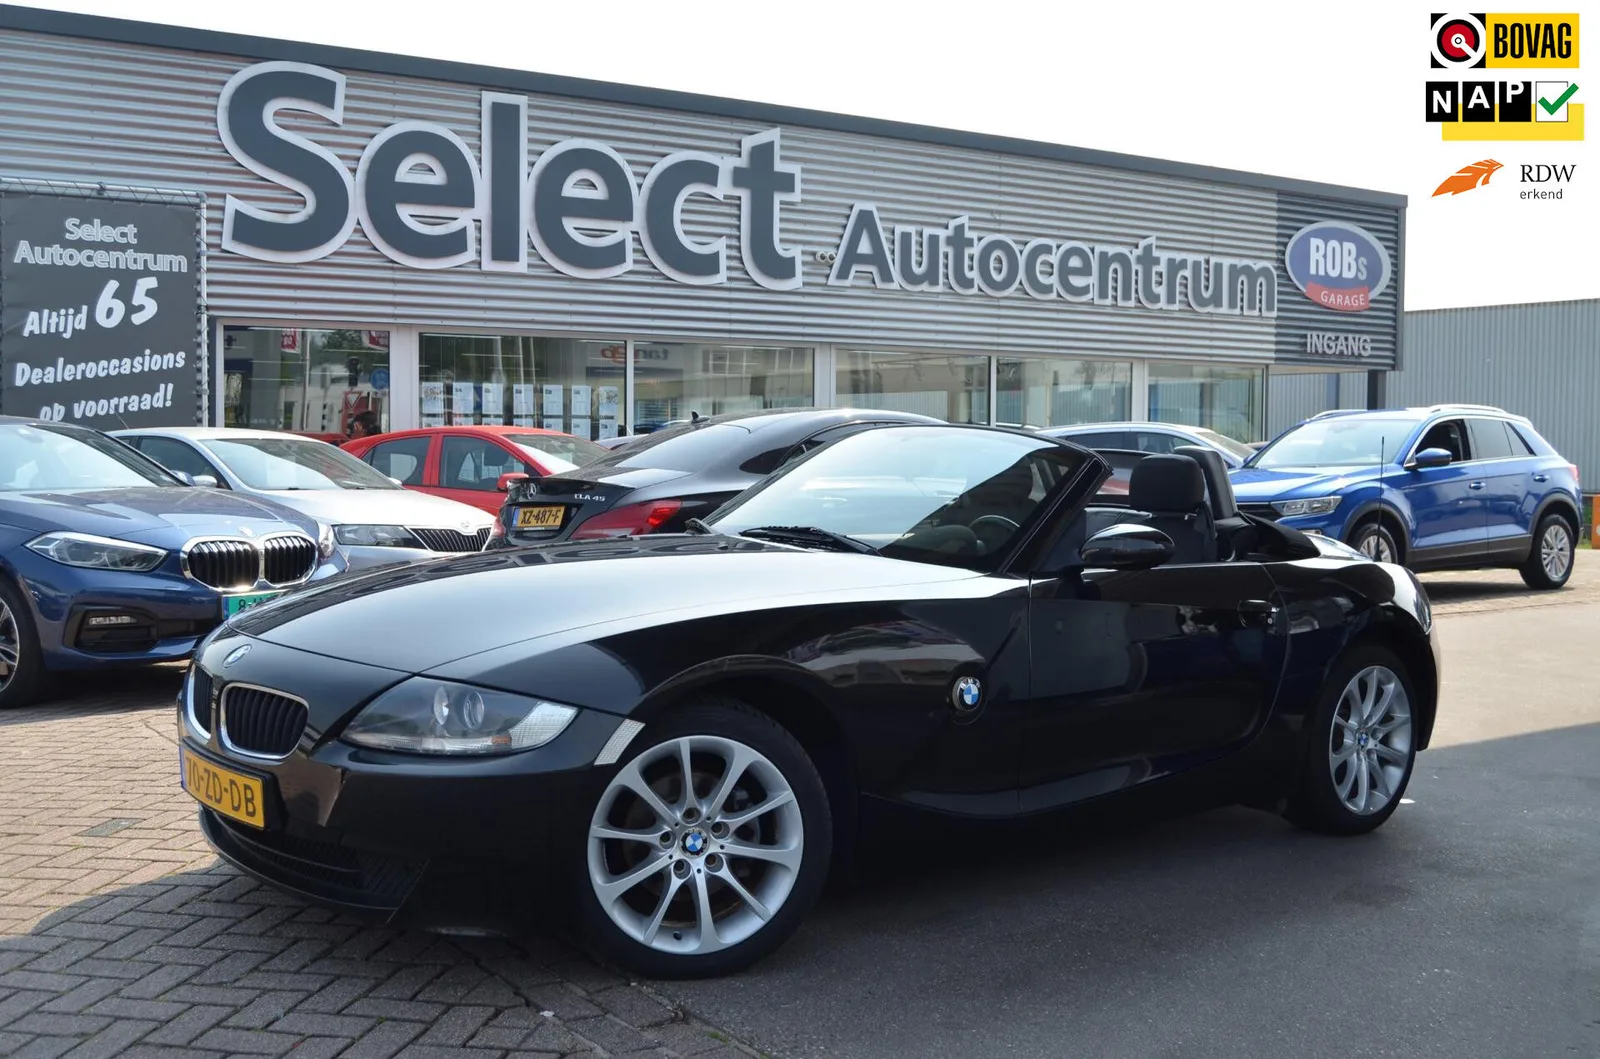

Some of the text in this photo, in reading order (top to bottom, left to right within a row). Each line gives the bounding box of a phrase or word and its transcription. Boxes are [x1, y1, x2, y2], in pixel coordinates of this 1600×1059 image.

[217, 61, 1277, 317] Select Autocentrum
[64, 217, 138, 244] Select
[13, 240, 188, 272] Autocentrum
[23, 276, 159, 339] Altijd 65
[1320, 290, 1366, 307] GARAGE
[1306, 332, 1372, 357] INGANG
[14, 349, 186, 387] Dealeroccasions
[40, 383, 174, 422] op voorraad!
[574, 493, 591, 501] CLA
[520, 508, 562, 525] XZ-487-F
[185, 756, 257, 818] 70-ZD-DB
